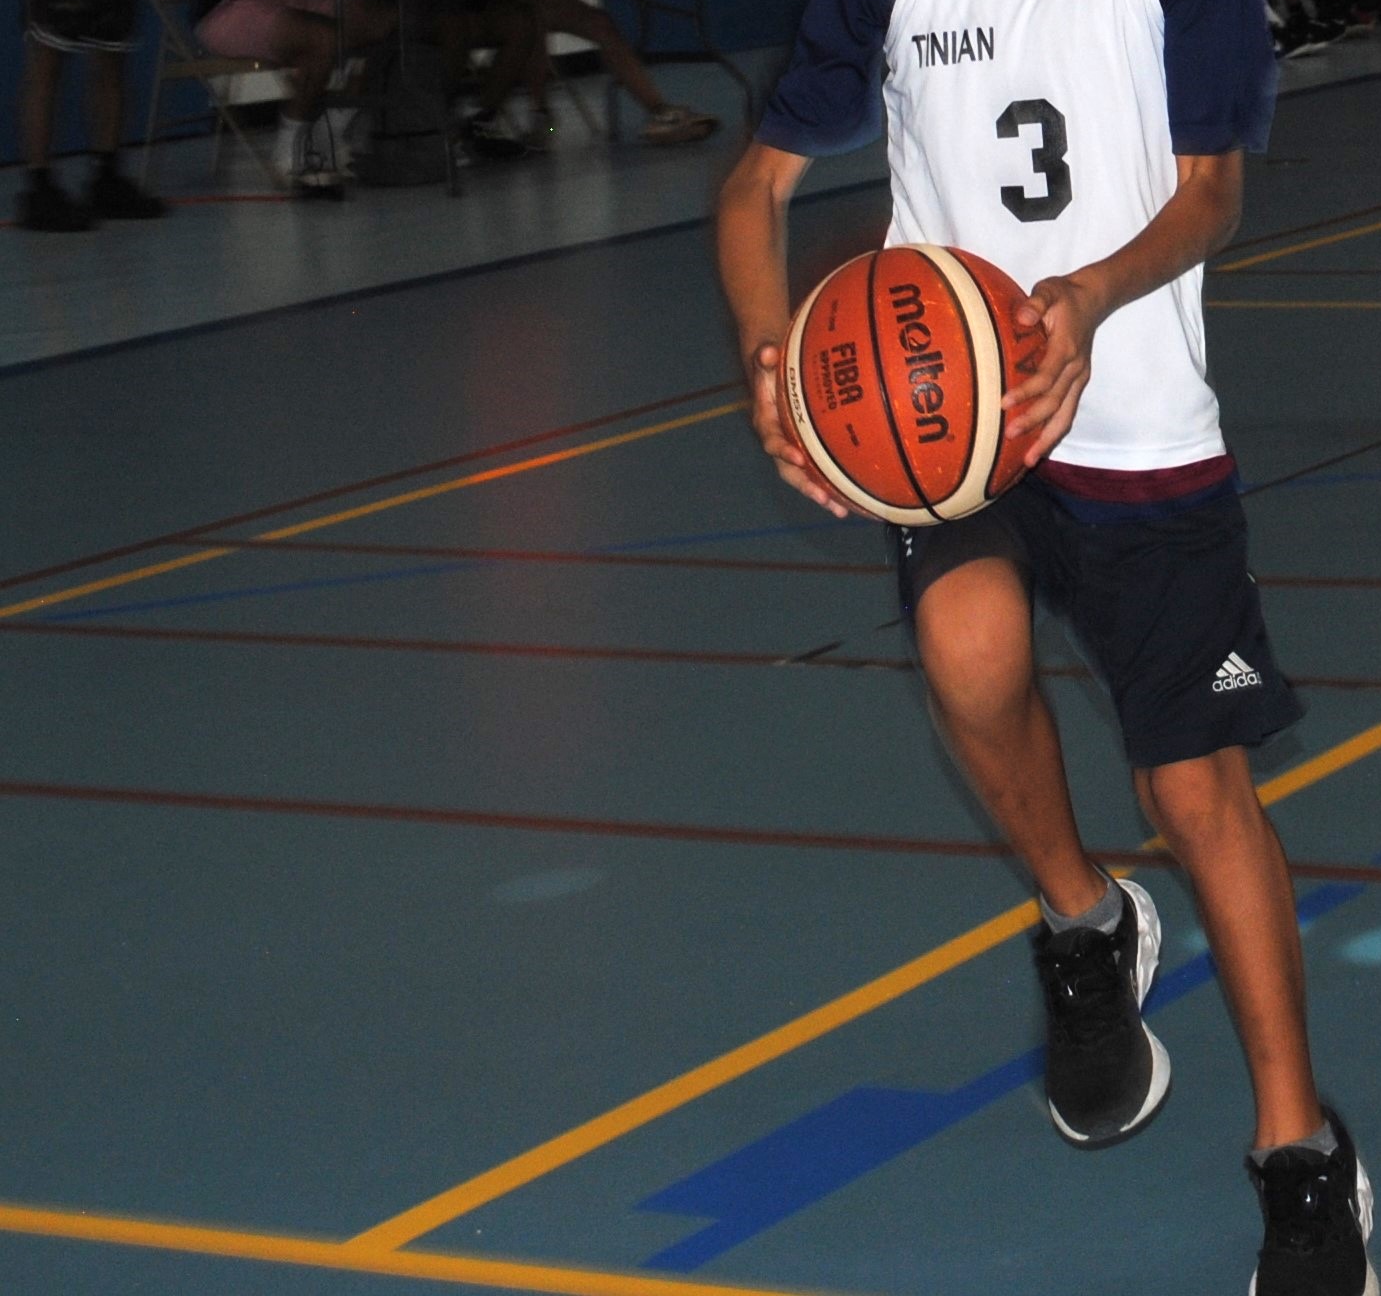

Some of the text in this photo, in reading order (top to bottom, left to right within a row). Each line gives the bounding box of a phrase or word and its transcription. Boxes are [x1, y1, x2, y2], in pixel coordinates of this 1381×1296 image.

[911, 26, 995, 69] TINIAN
[995, 98, 1073, 223] 3
[831, 341, 864, 406] FIBA
[888, 283, 949, 444] molten
